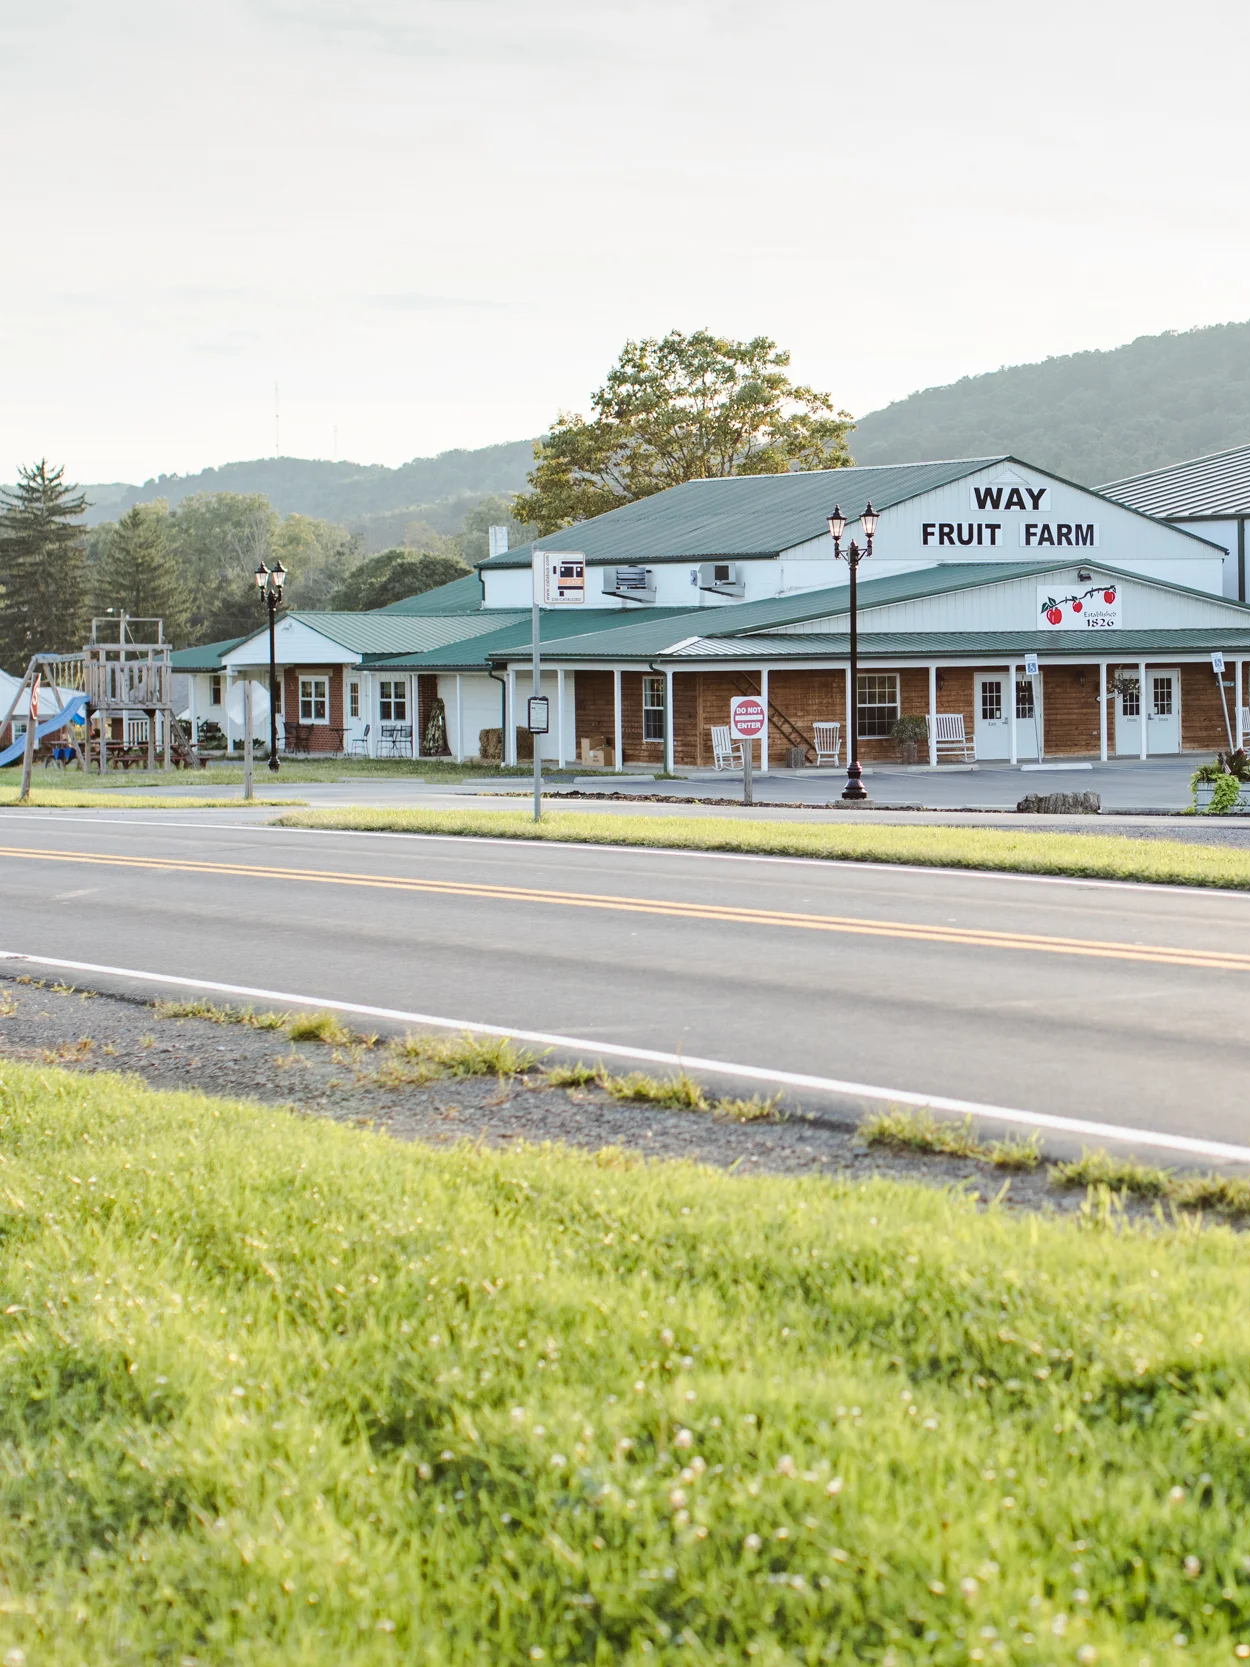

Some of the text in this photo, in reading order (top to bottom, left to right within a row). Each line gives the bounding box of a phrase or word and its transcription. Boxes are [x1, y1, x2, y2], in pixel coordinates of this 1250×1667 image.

[974, 487, 1047, 510] WAY
[922, 523, 1094, 546] FRUIT FARM
[1086, 618, 1115, 627] 1826
